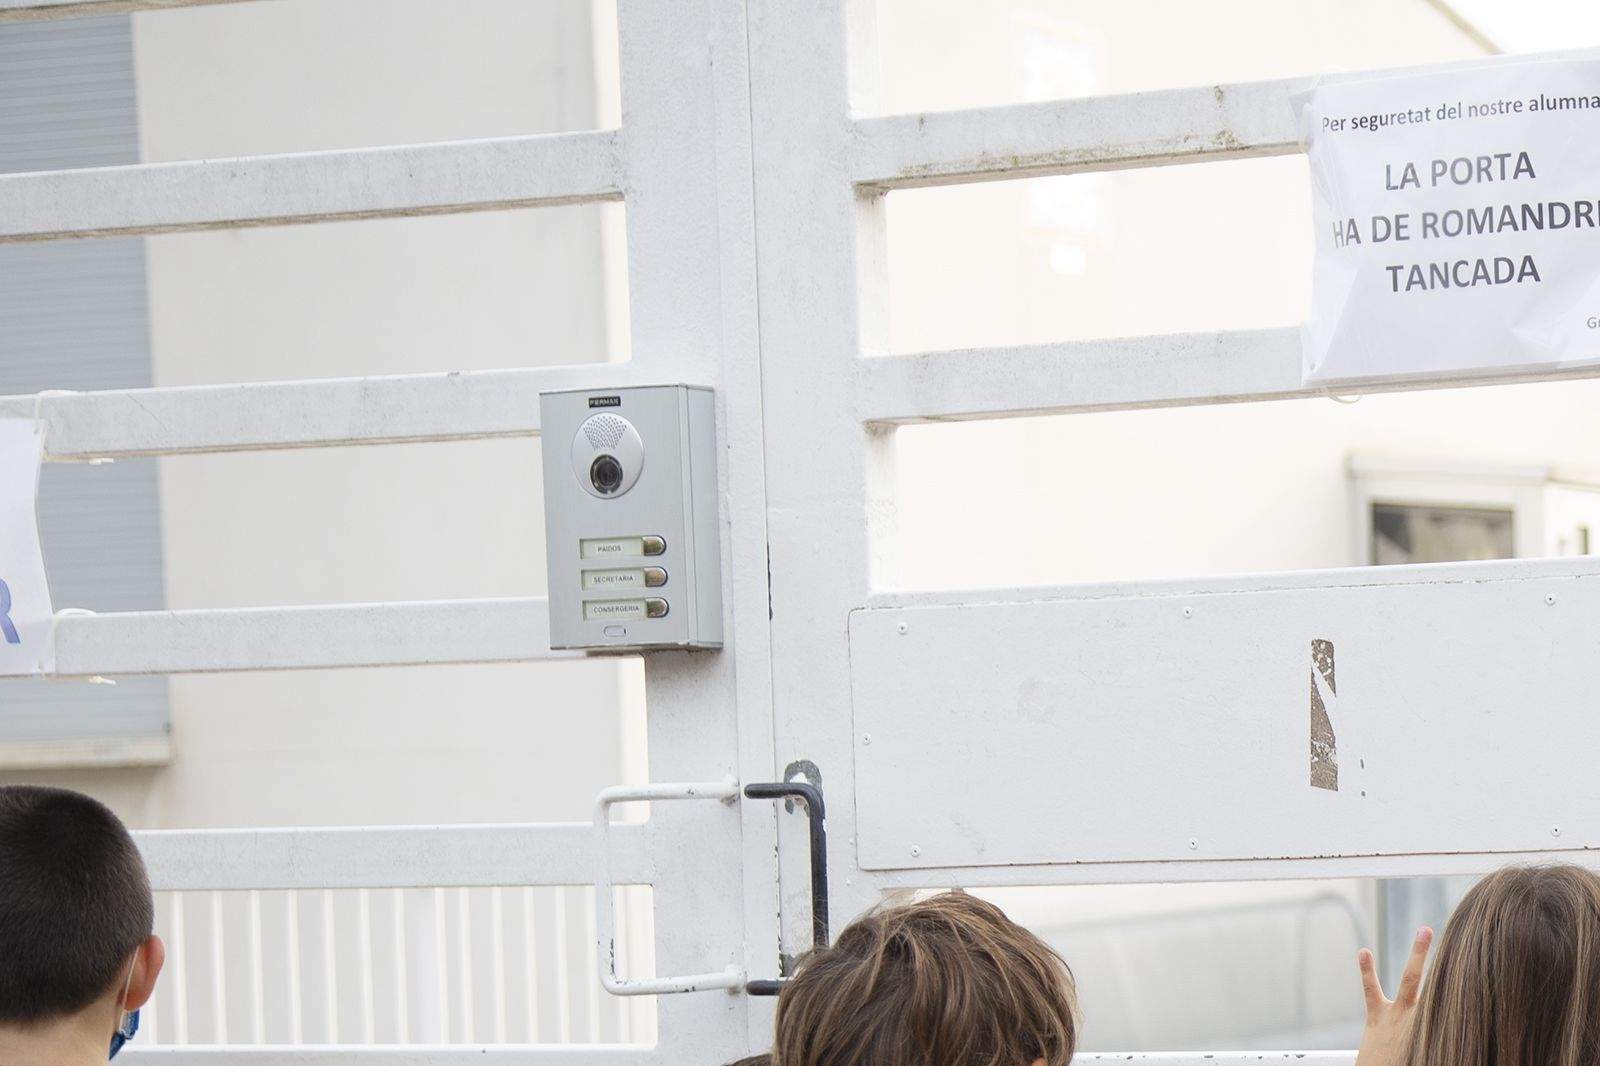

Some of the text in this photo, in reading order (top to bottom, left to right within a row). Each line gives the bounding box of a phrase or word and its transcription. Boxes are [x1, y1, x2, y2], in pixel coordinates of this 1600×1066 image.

[1322, 116, 1346, 133] Per
[1351, 107, 1431, 132] seguretat
[1436, 101, 1462, 121] del
[1468, 99, 1523, 118] nostre
[1385, 151, 1537, 191] LA PORTA
[1332, 217, 1362, 249] HA
[1371, 213, 1410, 243] DE
[1385, 255, 1541, 293] TANCADA
[593, 575, 634, 583] SECRETARIA
